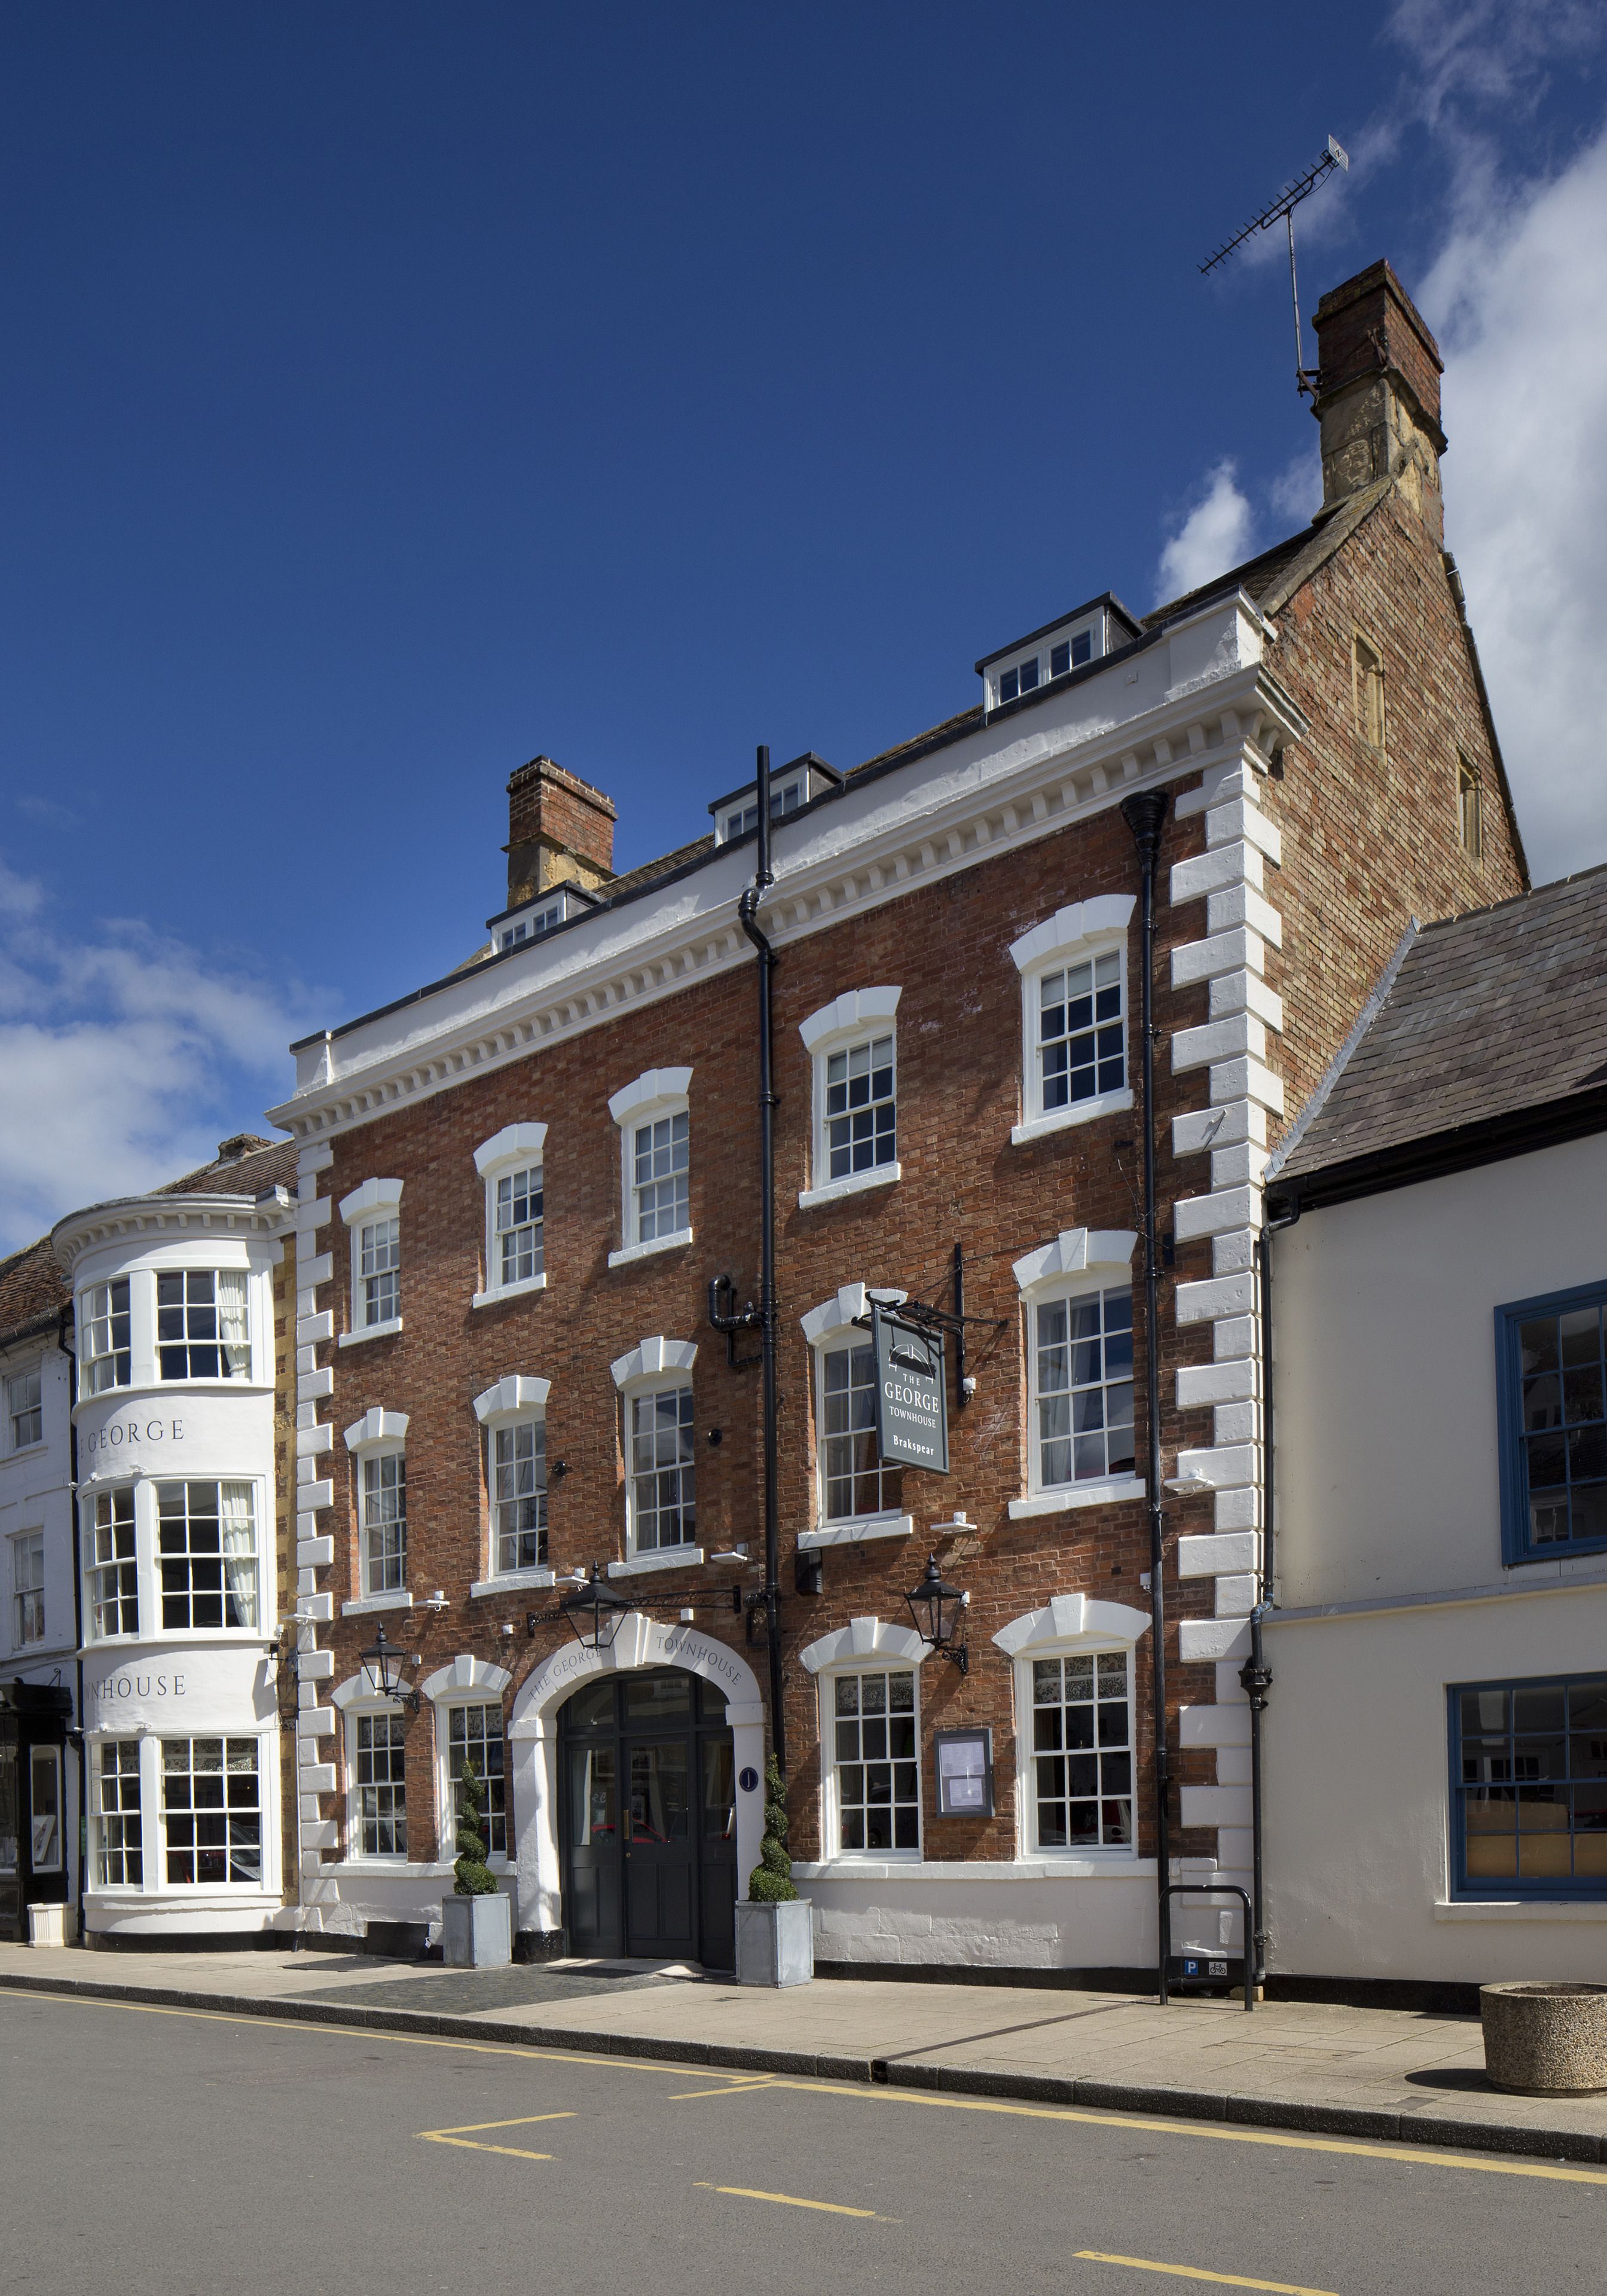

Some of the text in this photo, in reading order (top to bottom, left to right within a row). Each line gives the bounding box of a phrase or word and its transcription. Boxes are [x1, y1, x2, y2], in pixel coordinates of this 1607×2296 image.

[903, 1373, 921, 1386] THE
[884, 1382, 939, 1413] GEORGE
[889, 1406, 936, 1428] TOWNHOUSE
[88, 1419, 184, 1453] GEORGE
[893, 1434, 934, 1455] Brakspear
[657, 1636, 741, 1685] TOWNHOUSE
[527, 1674, 550, 1700] THE
[1187, 1962, 1196, 1973] P
